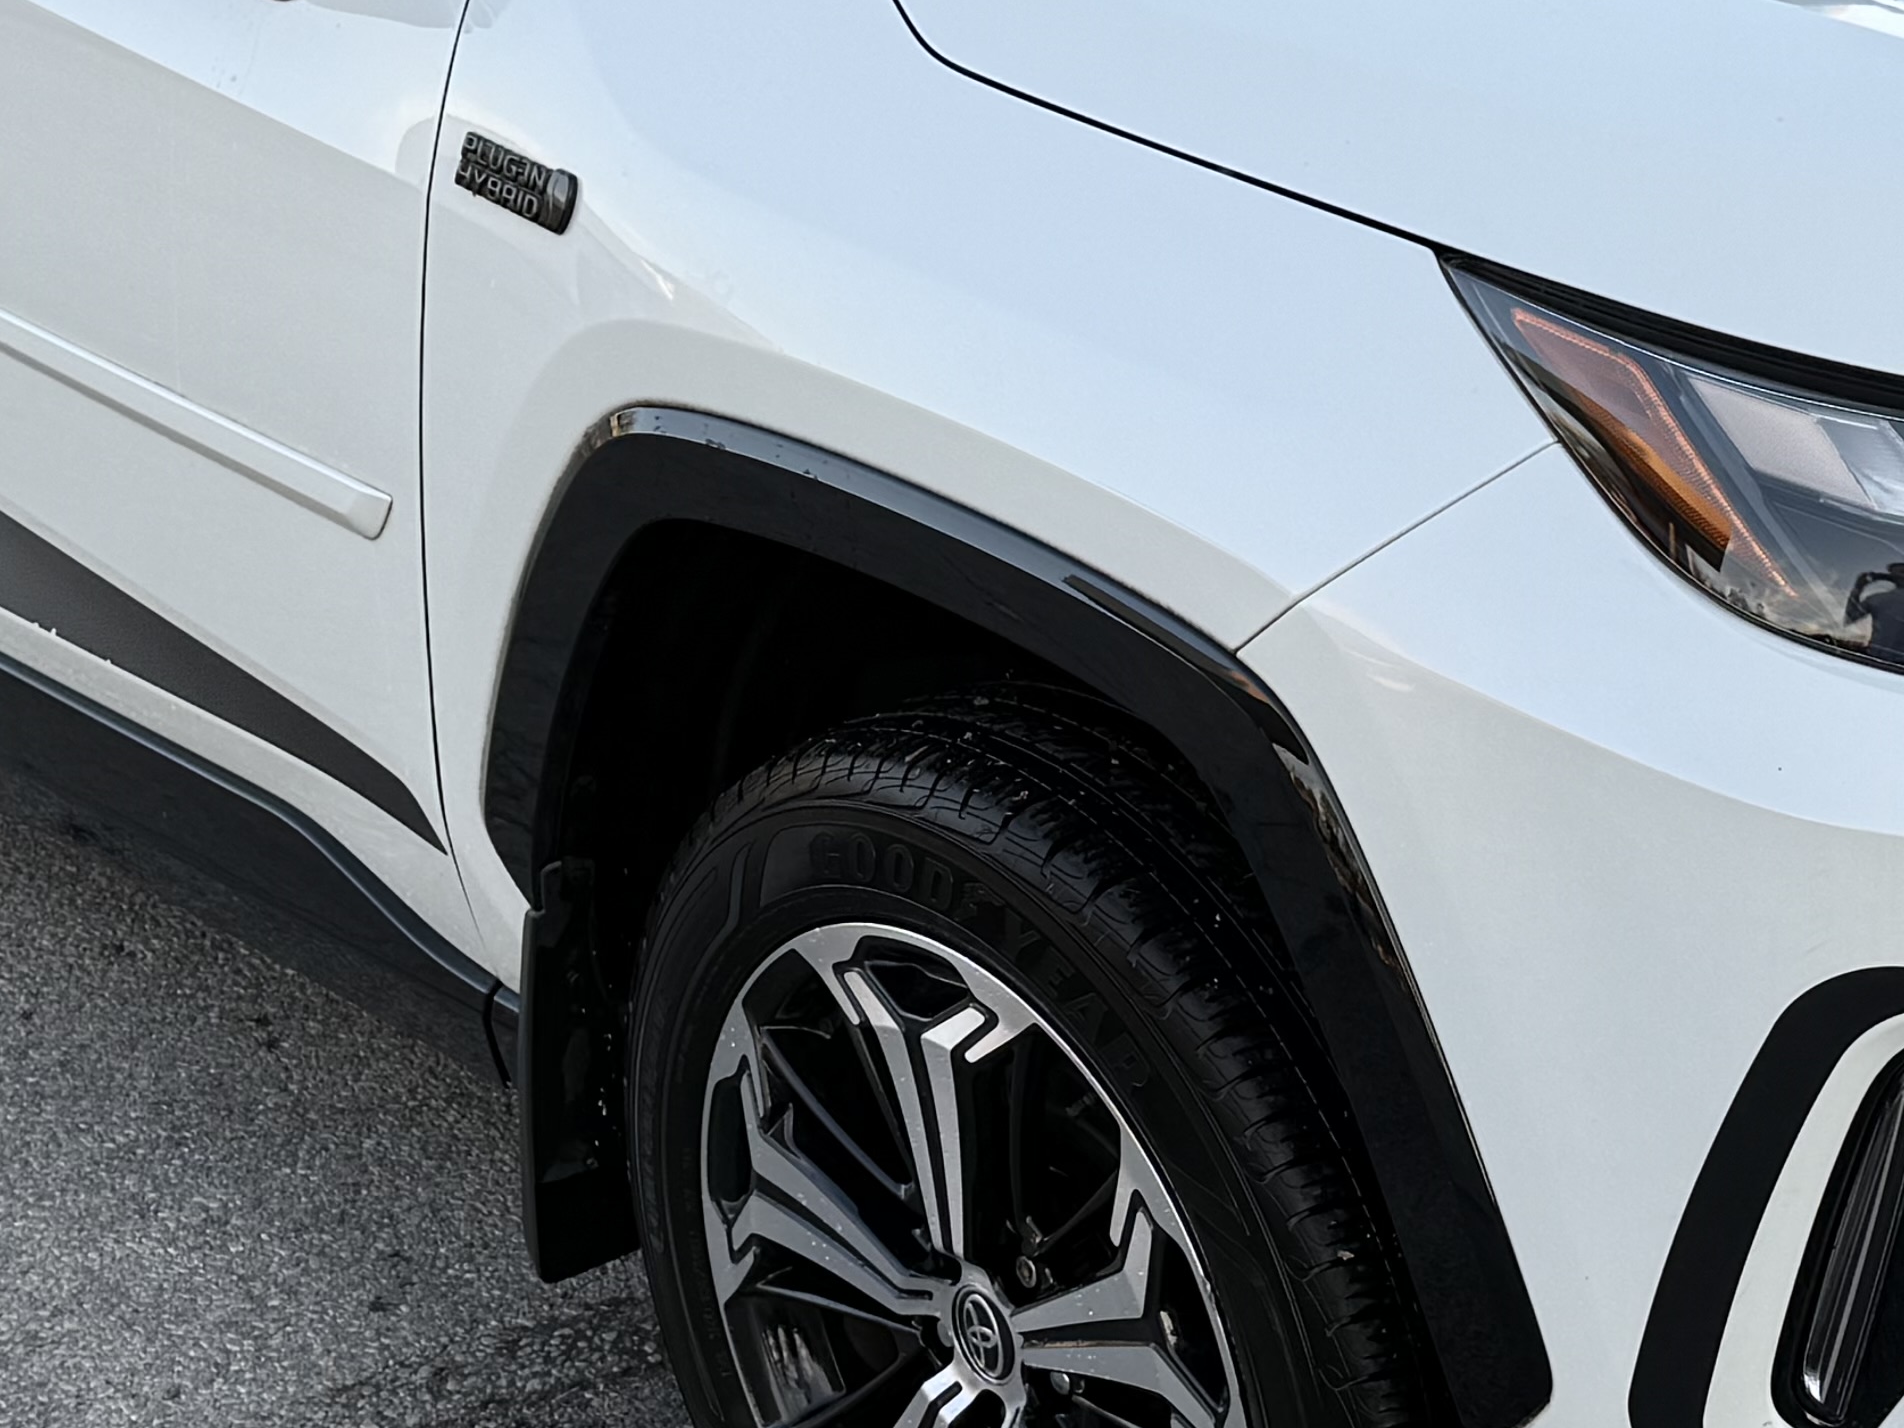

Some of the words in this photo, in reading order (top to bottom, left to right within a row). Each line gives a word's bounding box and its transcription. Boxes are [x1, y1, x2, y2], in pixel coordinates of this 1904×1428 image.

[457, 162, 539, 218] HYBRID
[463, 134, 546, 190] PLUG-IN
[808, 829, 1152, 1089] GOODYEAR
